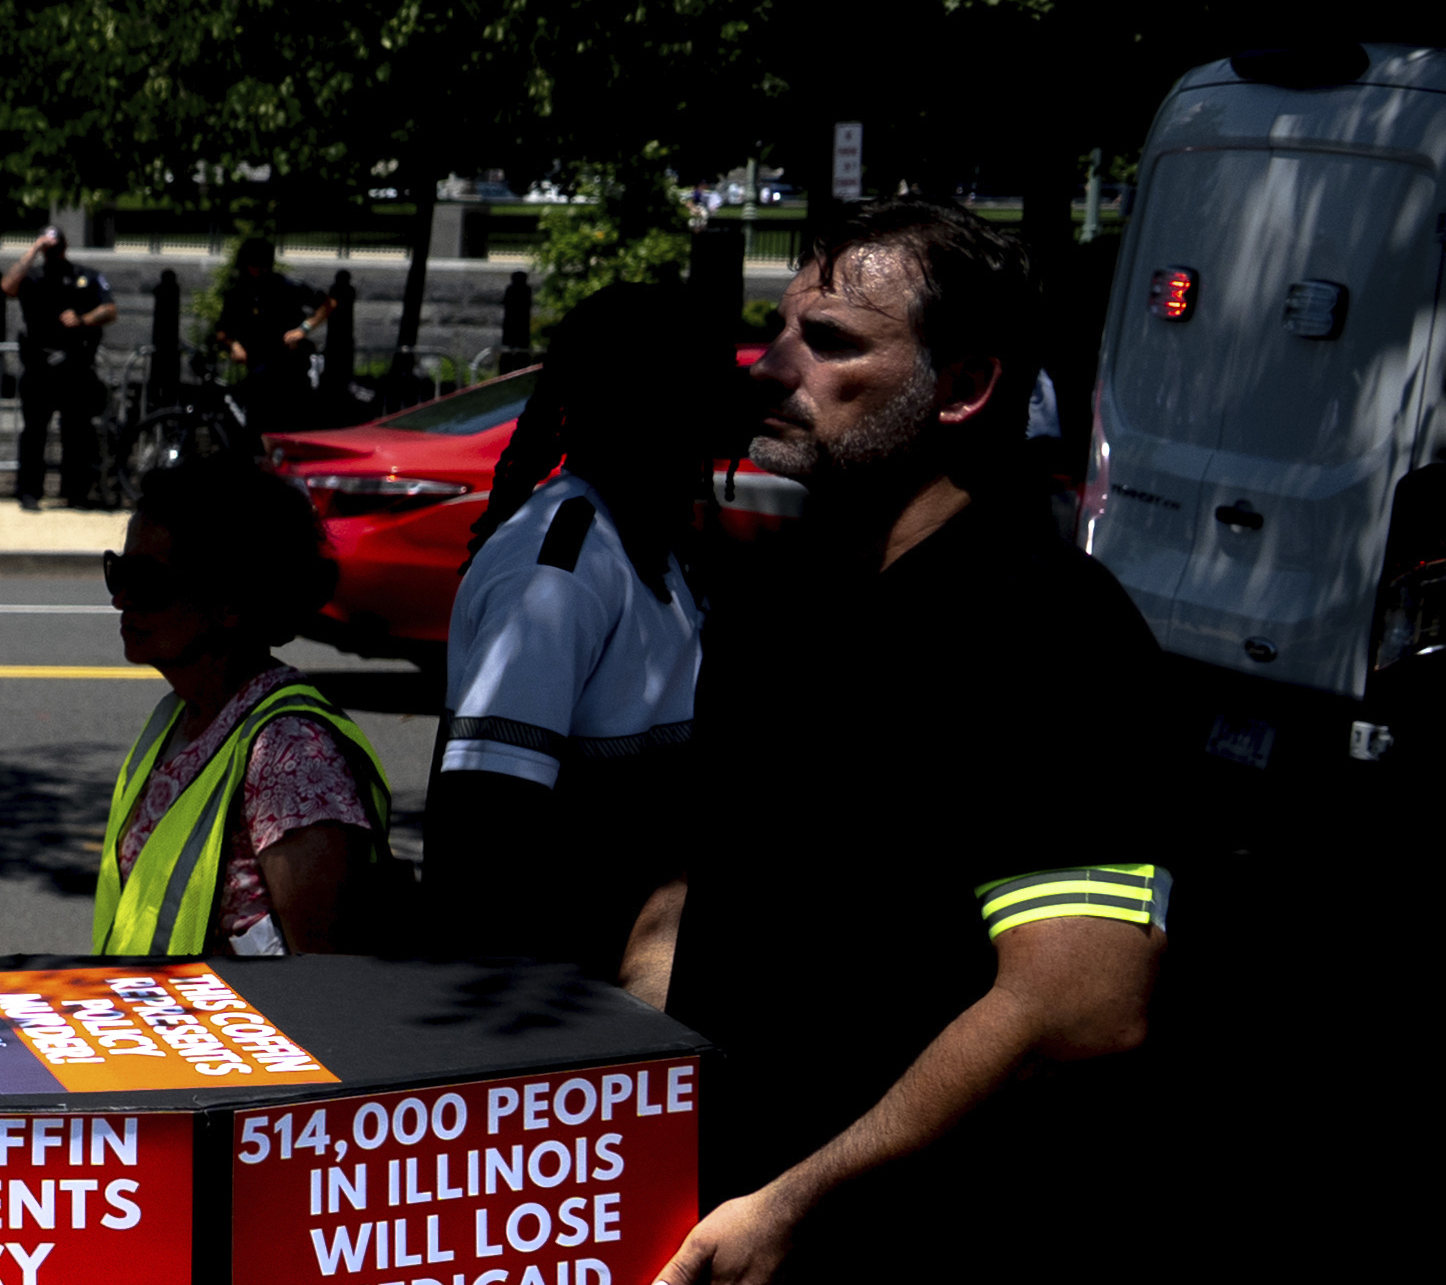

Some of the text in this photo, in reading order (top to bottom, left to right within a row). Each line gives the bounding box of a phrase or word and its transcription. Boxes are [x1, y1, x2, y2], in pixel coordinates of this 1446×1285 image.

[60, 998, 167, 1058] POLICY
[104, 976, 253, 1076] REPRESENTS
[168, 973, 321, 1073] THIS COFFIN
[233, 1065, 694, 1165] 514,000 PEOPLE
[310, 1132, 625, 1216] IN ILLINOIS
[309, 1192, 621, 1277] WILL LOSE
